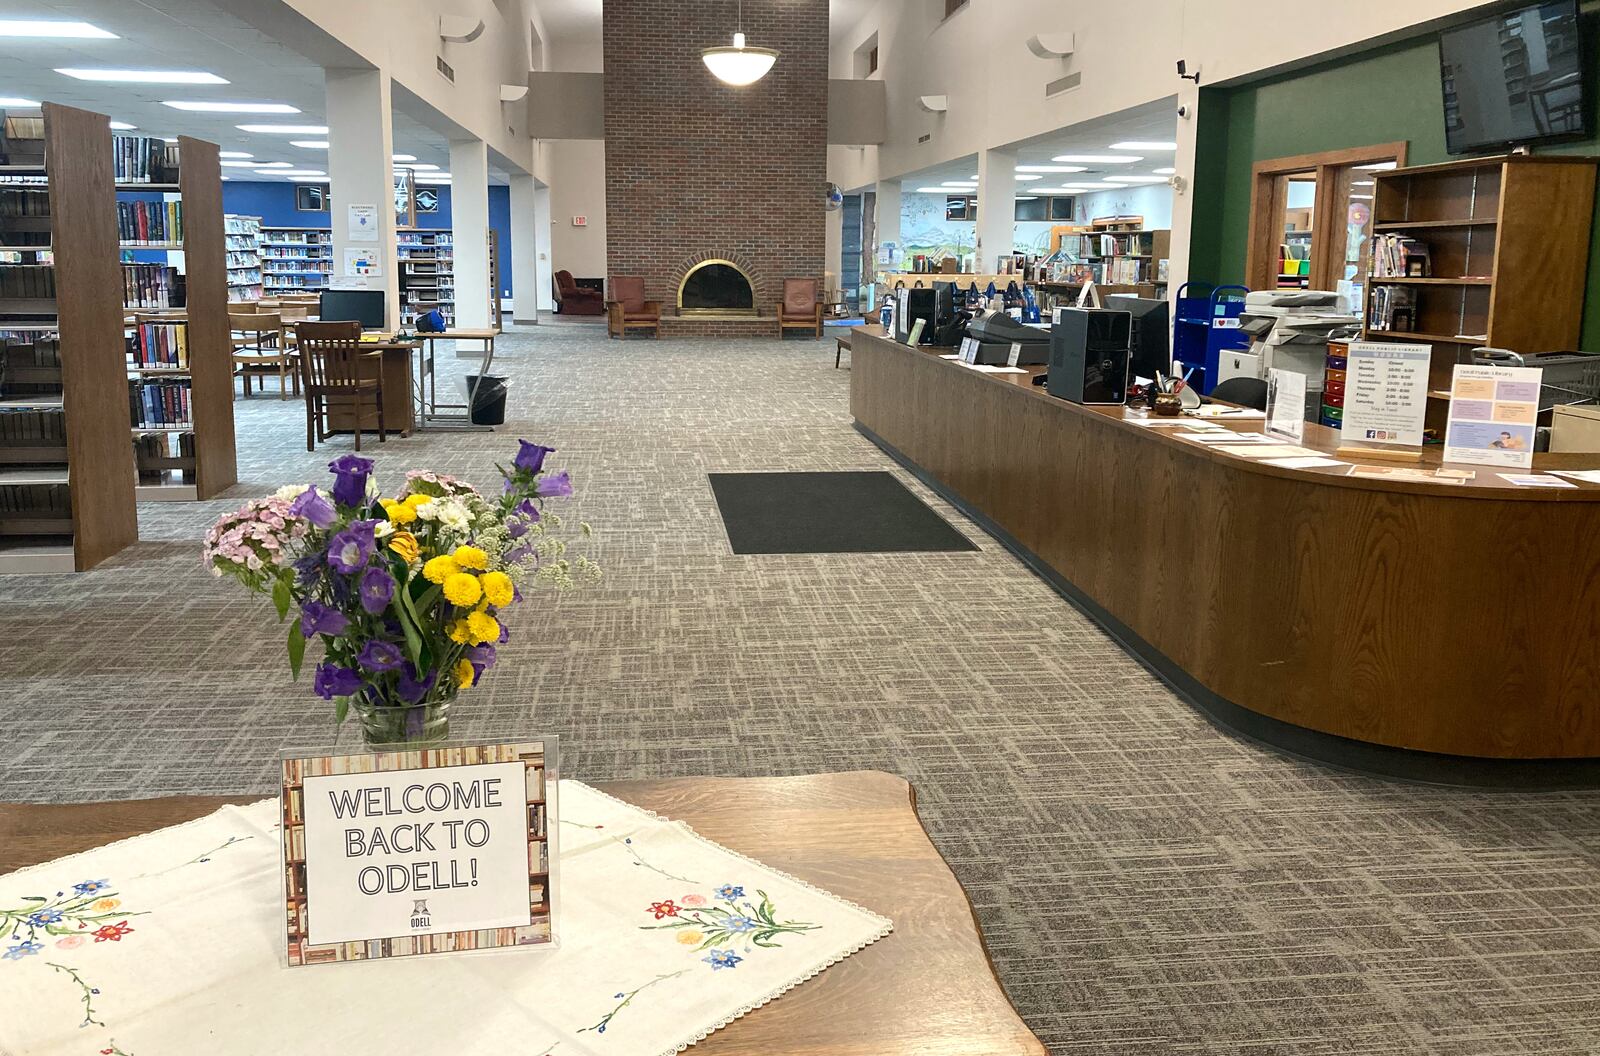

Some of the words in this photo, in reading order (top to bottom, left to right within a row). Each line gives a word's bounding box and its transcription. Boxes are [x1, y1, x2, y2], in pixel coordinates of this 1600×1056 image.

[328, 778, 502, 819] WELCOME
[345, 822, 436, 858] BACK
[442, 819, 490, 849] TO
[358, 858, 478, 896] ODELL!
[410, 917, 431, 928] ODELL
